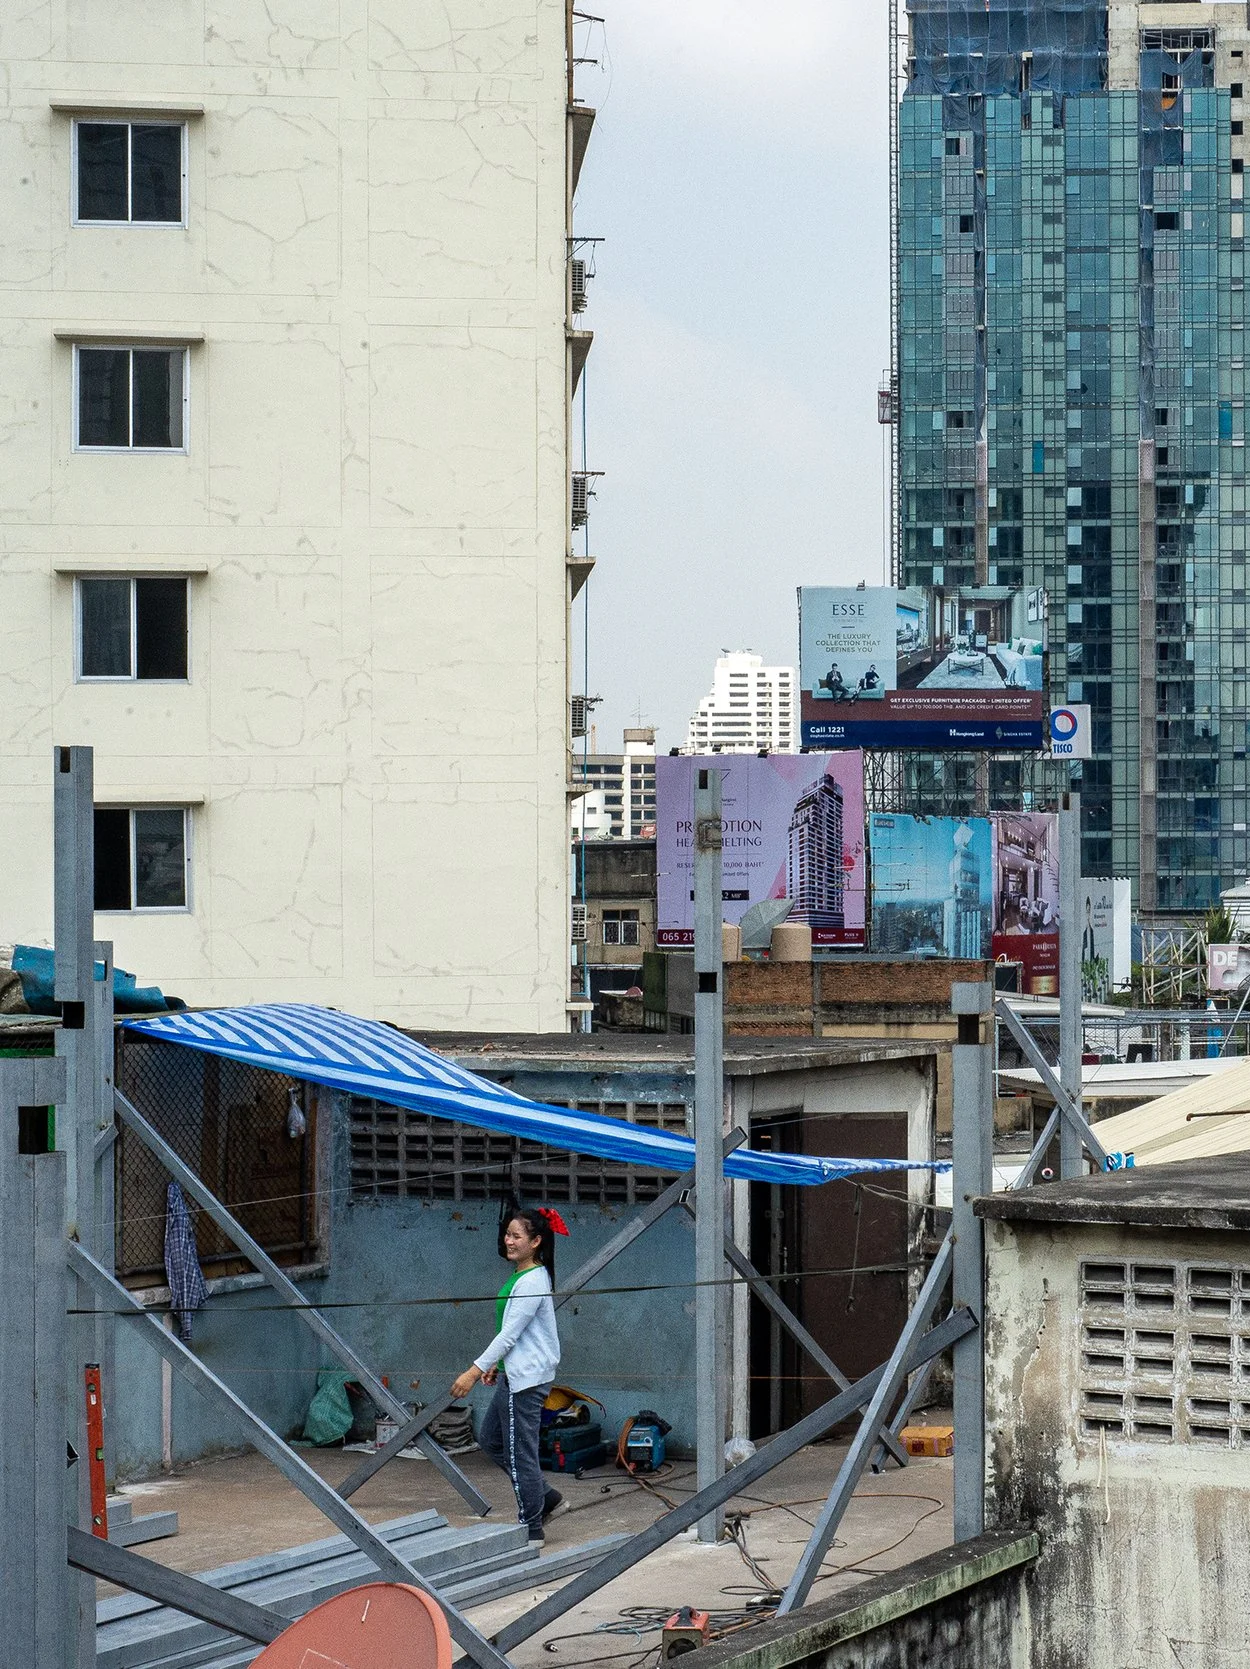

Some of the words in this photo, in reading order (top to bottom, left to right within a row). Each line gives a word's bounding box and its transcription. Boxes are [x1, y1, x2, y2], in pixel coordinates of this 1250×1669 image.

[832, 604, 865, 616] ESSE
[1053, 744, 1073, 753] TISCO
[662, 932, 680, 941] 065
